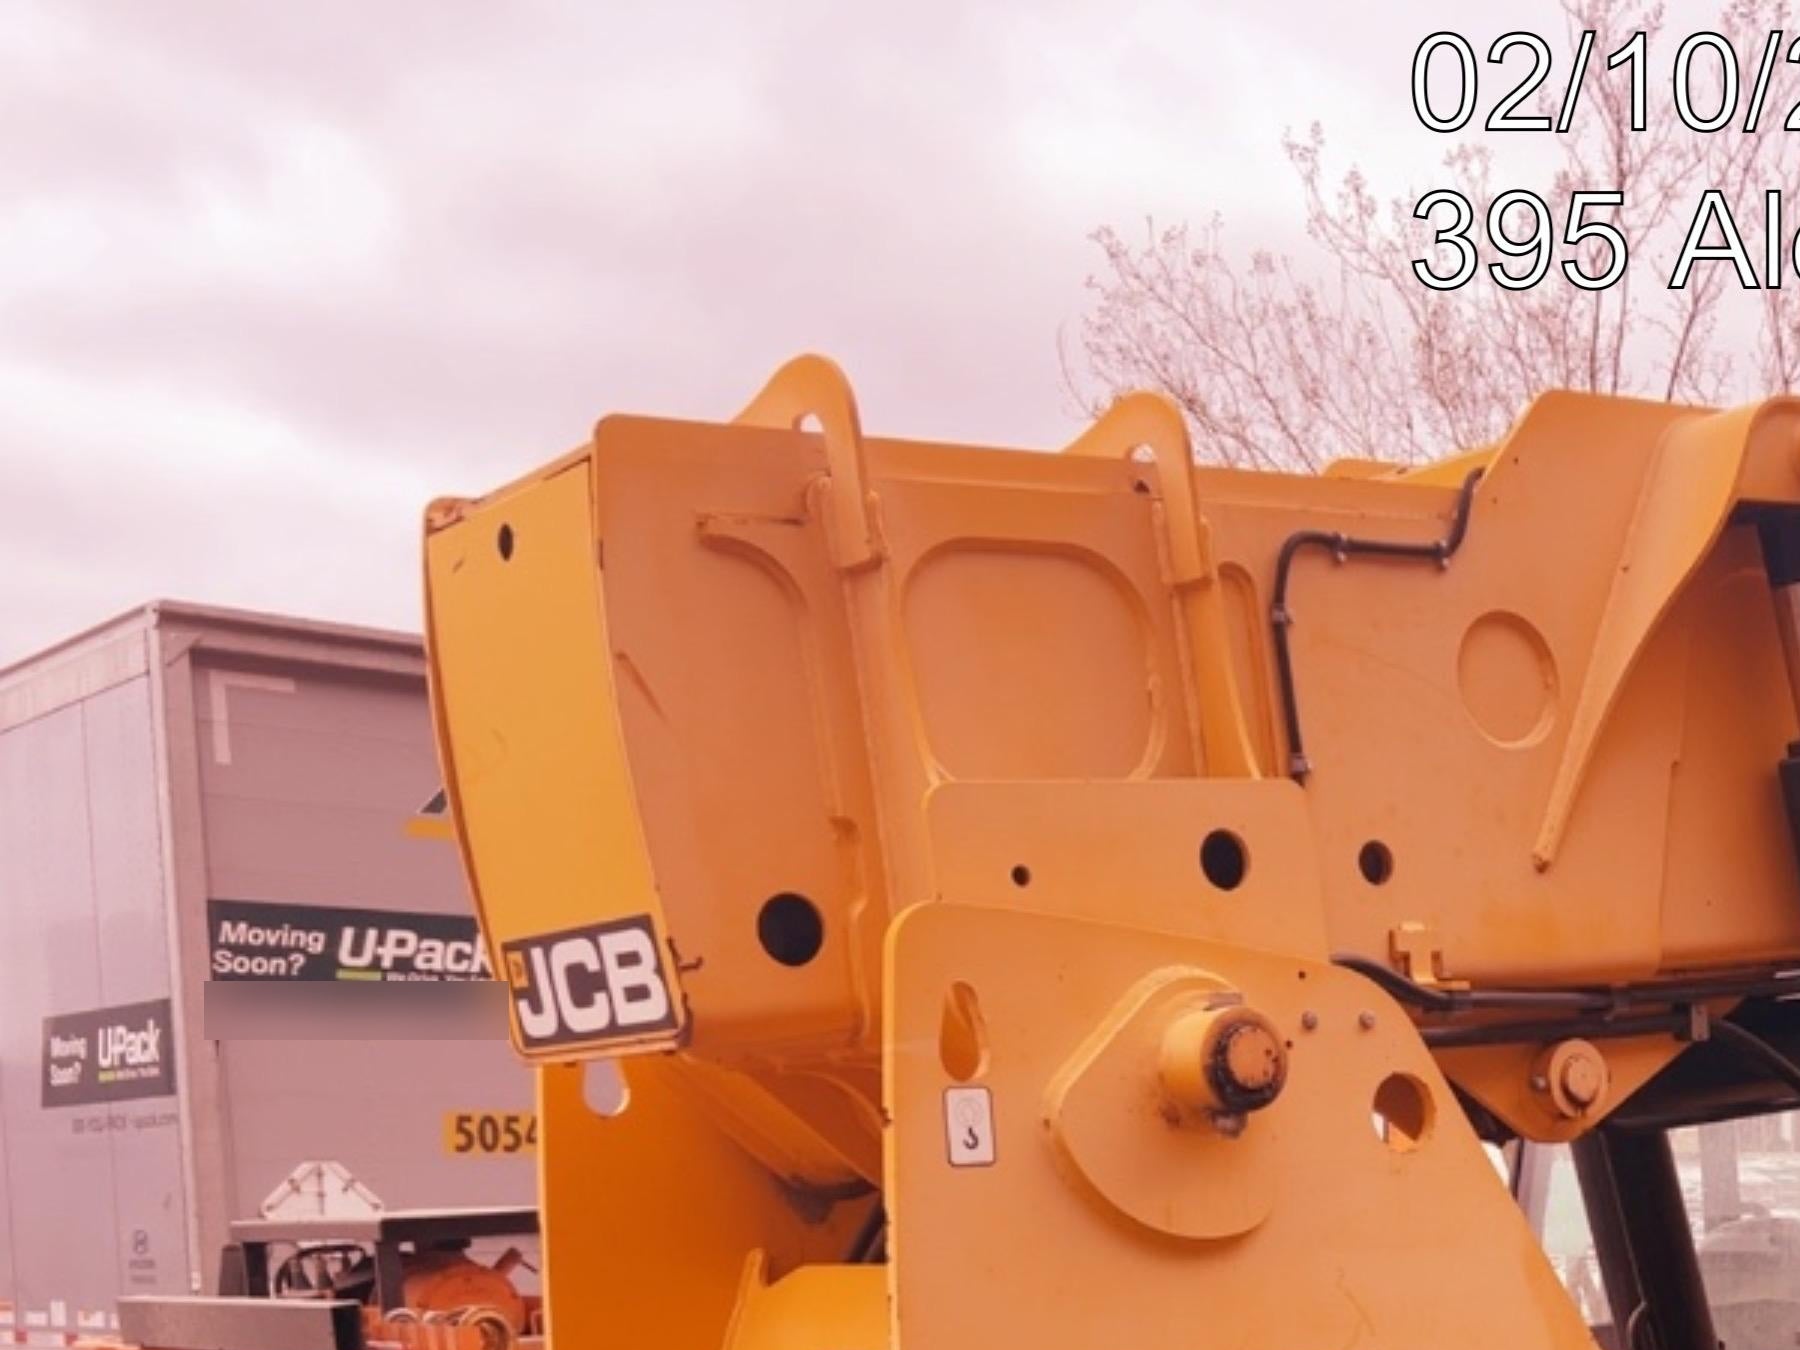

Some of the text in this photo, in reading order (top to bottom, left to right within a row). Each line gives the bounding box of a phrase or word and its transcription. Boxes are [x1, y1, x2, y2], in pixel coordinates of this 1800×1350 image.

[218, 919, 326, 954] Moving
[212, 950, 307, 977] Soon?
[516, 928, 669, 1040] JCB
